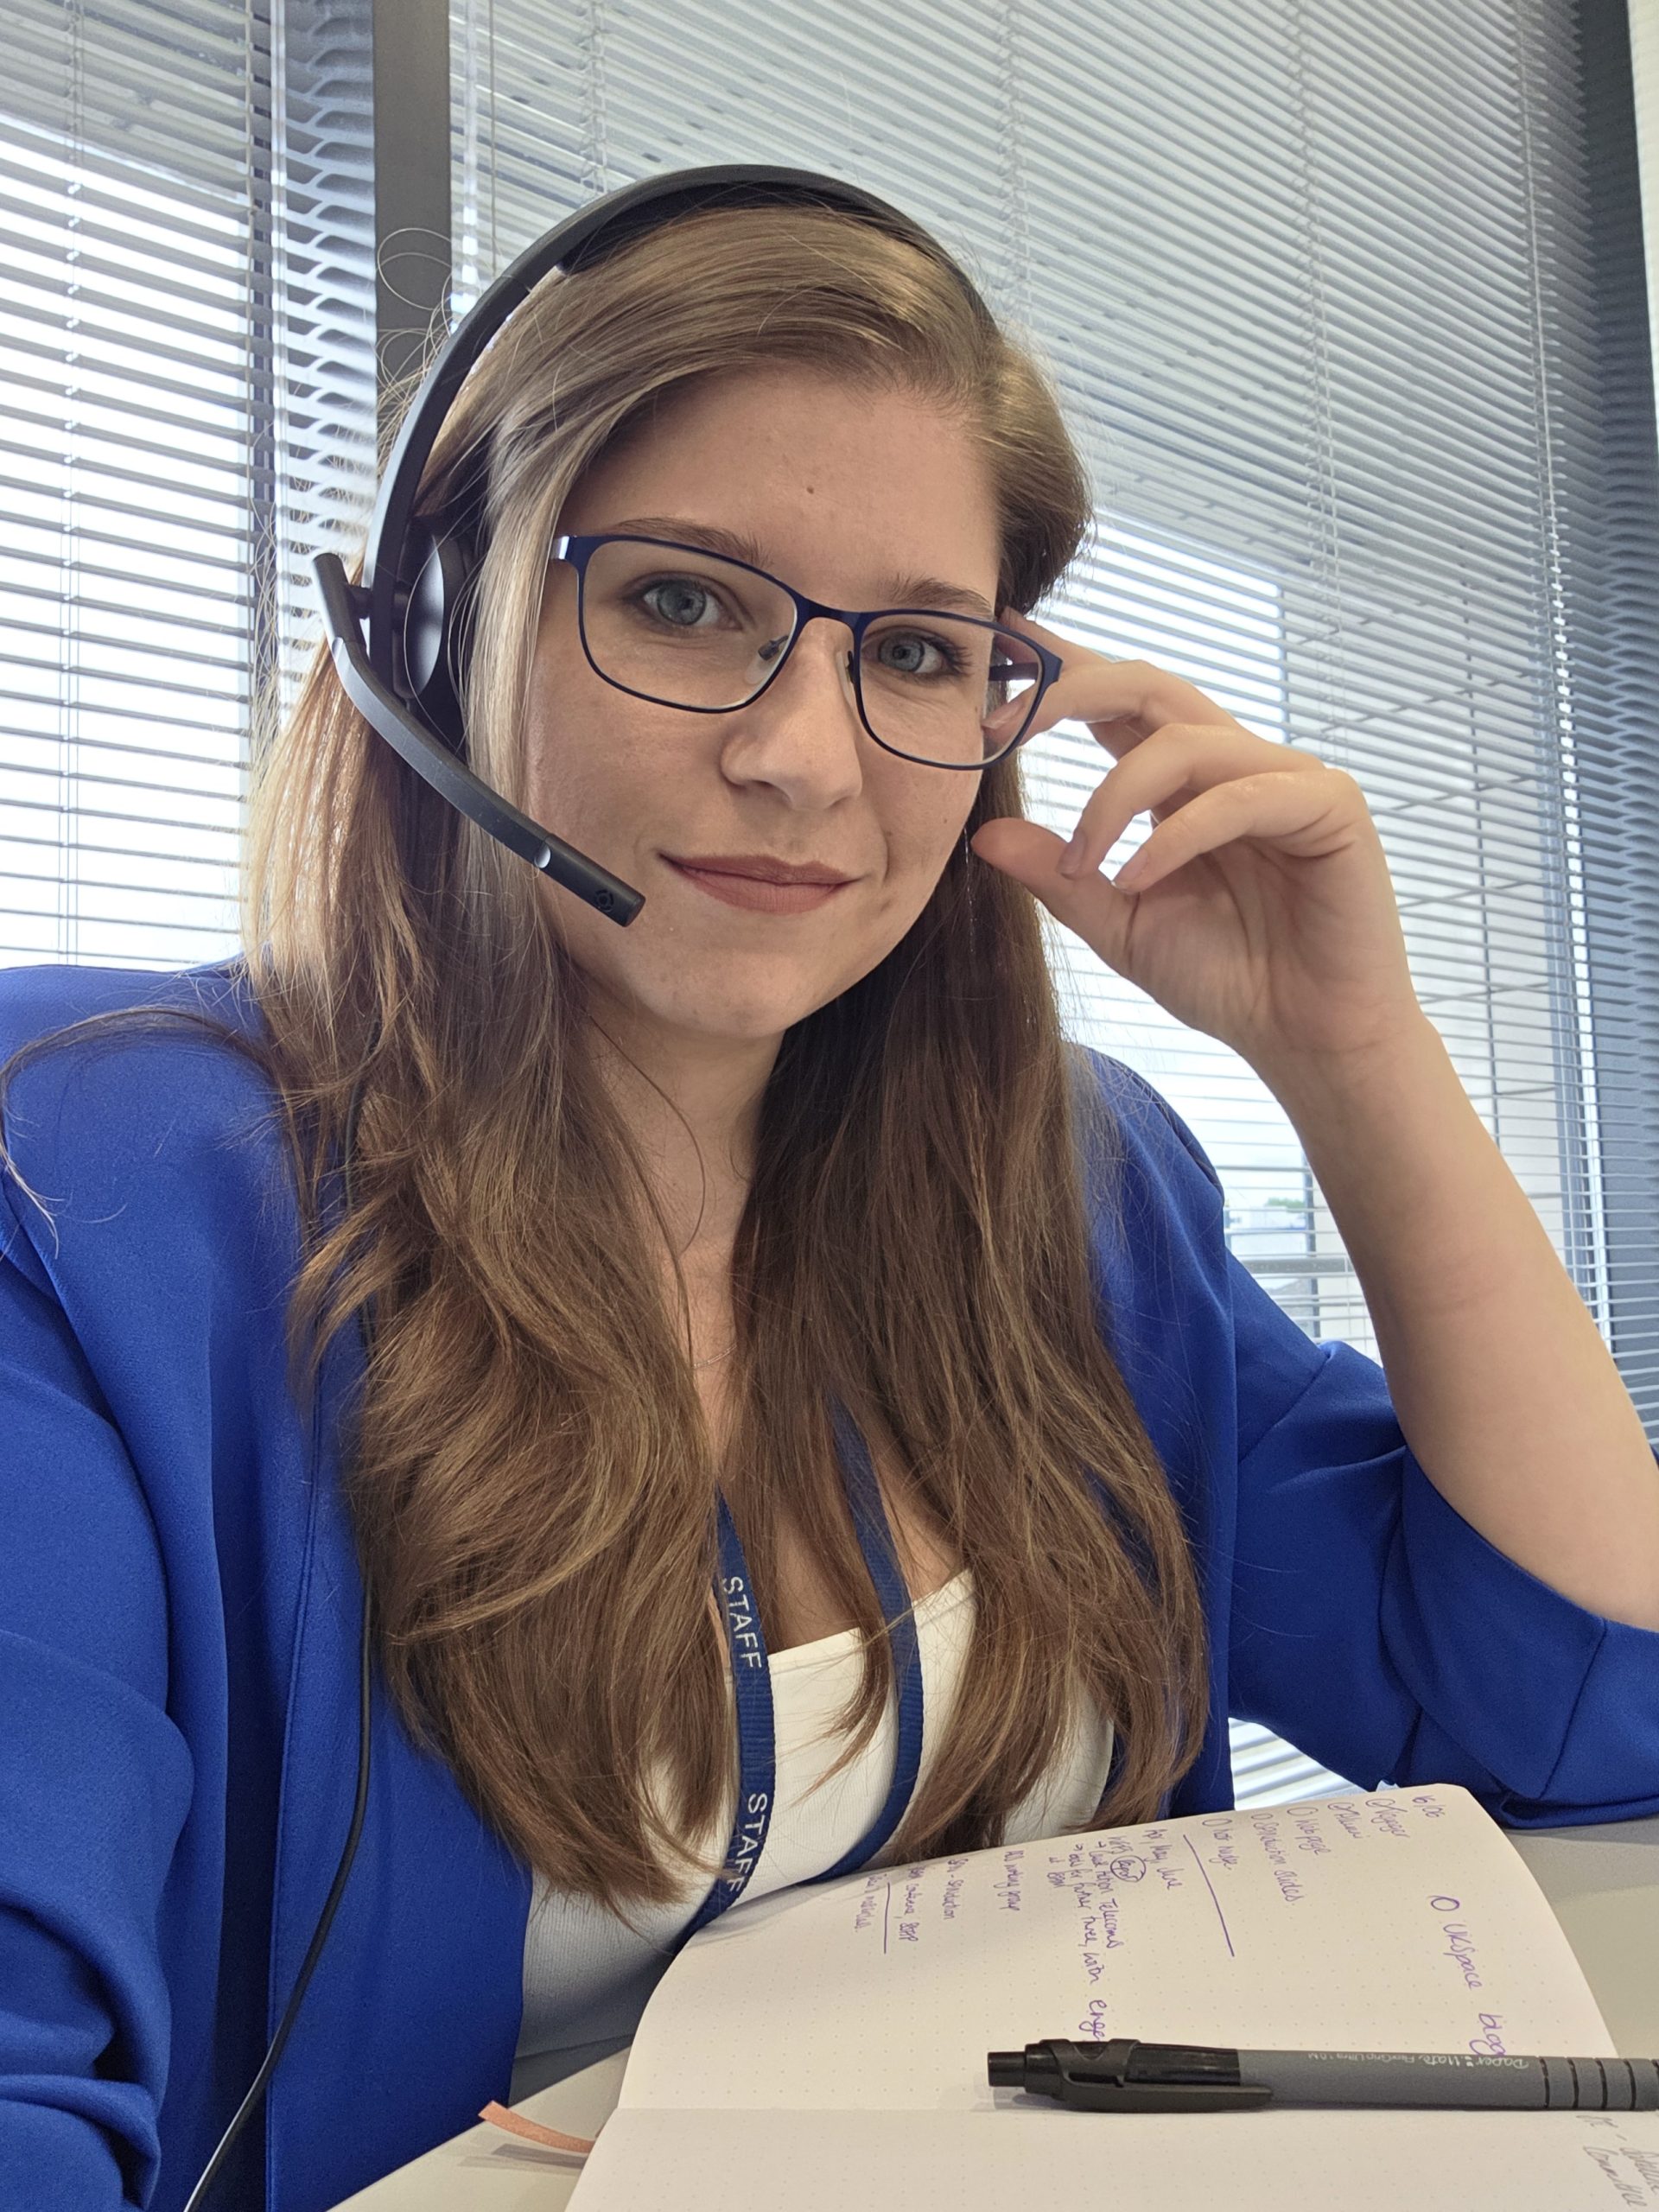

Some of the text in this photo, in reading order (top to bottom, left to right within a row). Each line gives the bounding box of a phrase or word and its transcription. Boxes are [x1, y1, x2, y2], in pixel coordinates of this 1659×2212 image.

[722, 1576, 762, 1668] STAFF
[727, 1793, 767, 1891] STAFF
[1468, 2012, 1505, 2056] blog
